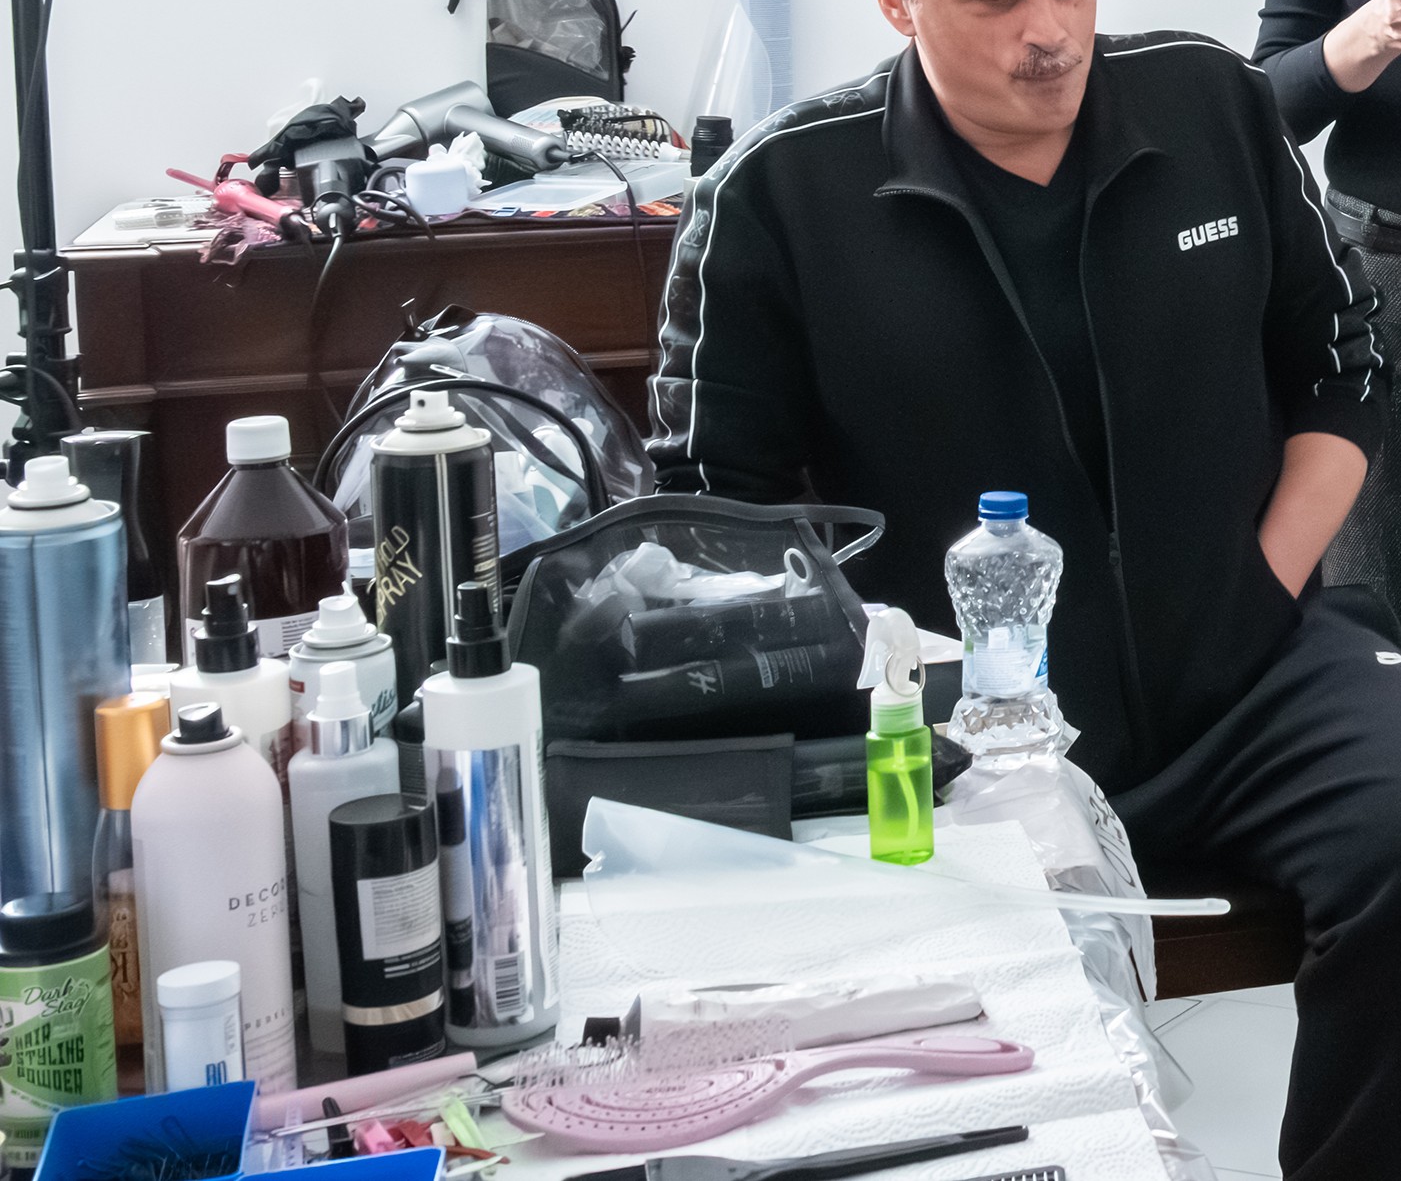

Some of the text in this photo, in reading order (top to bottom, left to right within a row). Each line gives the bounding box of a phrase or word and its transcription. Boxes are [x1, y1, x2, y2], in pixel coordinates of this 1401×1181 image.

[1177, 215, 1239, 251] GUESS
[23, 976, 74, 1006] Dark
[15, 1022, 51, 1051] HAIR
[16, 1035, 85, 1066] STYLING
